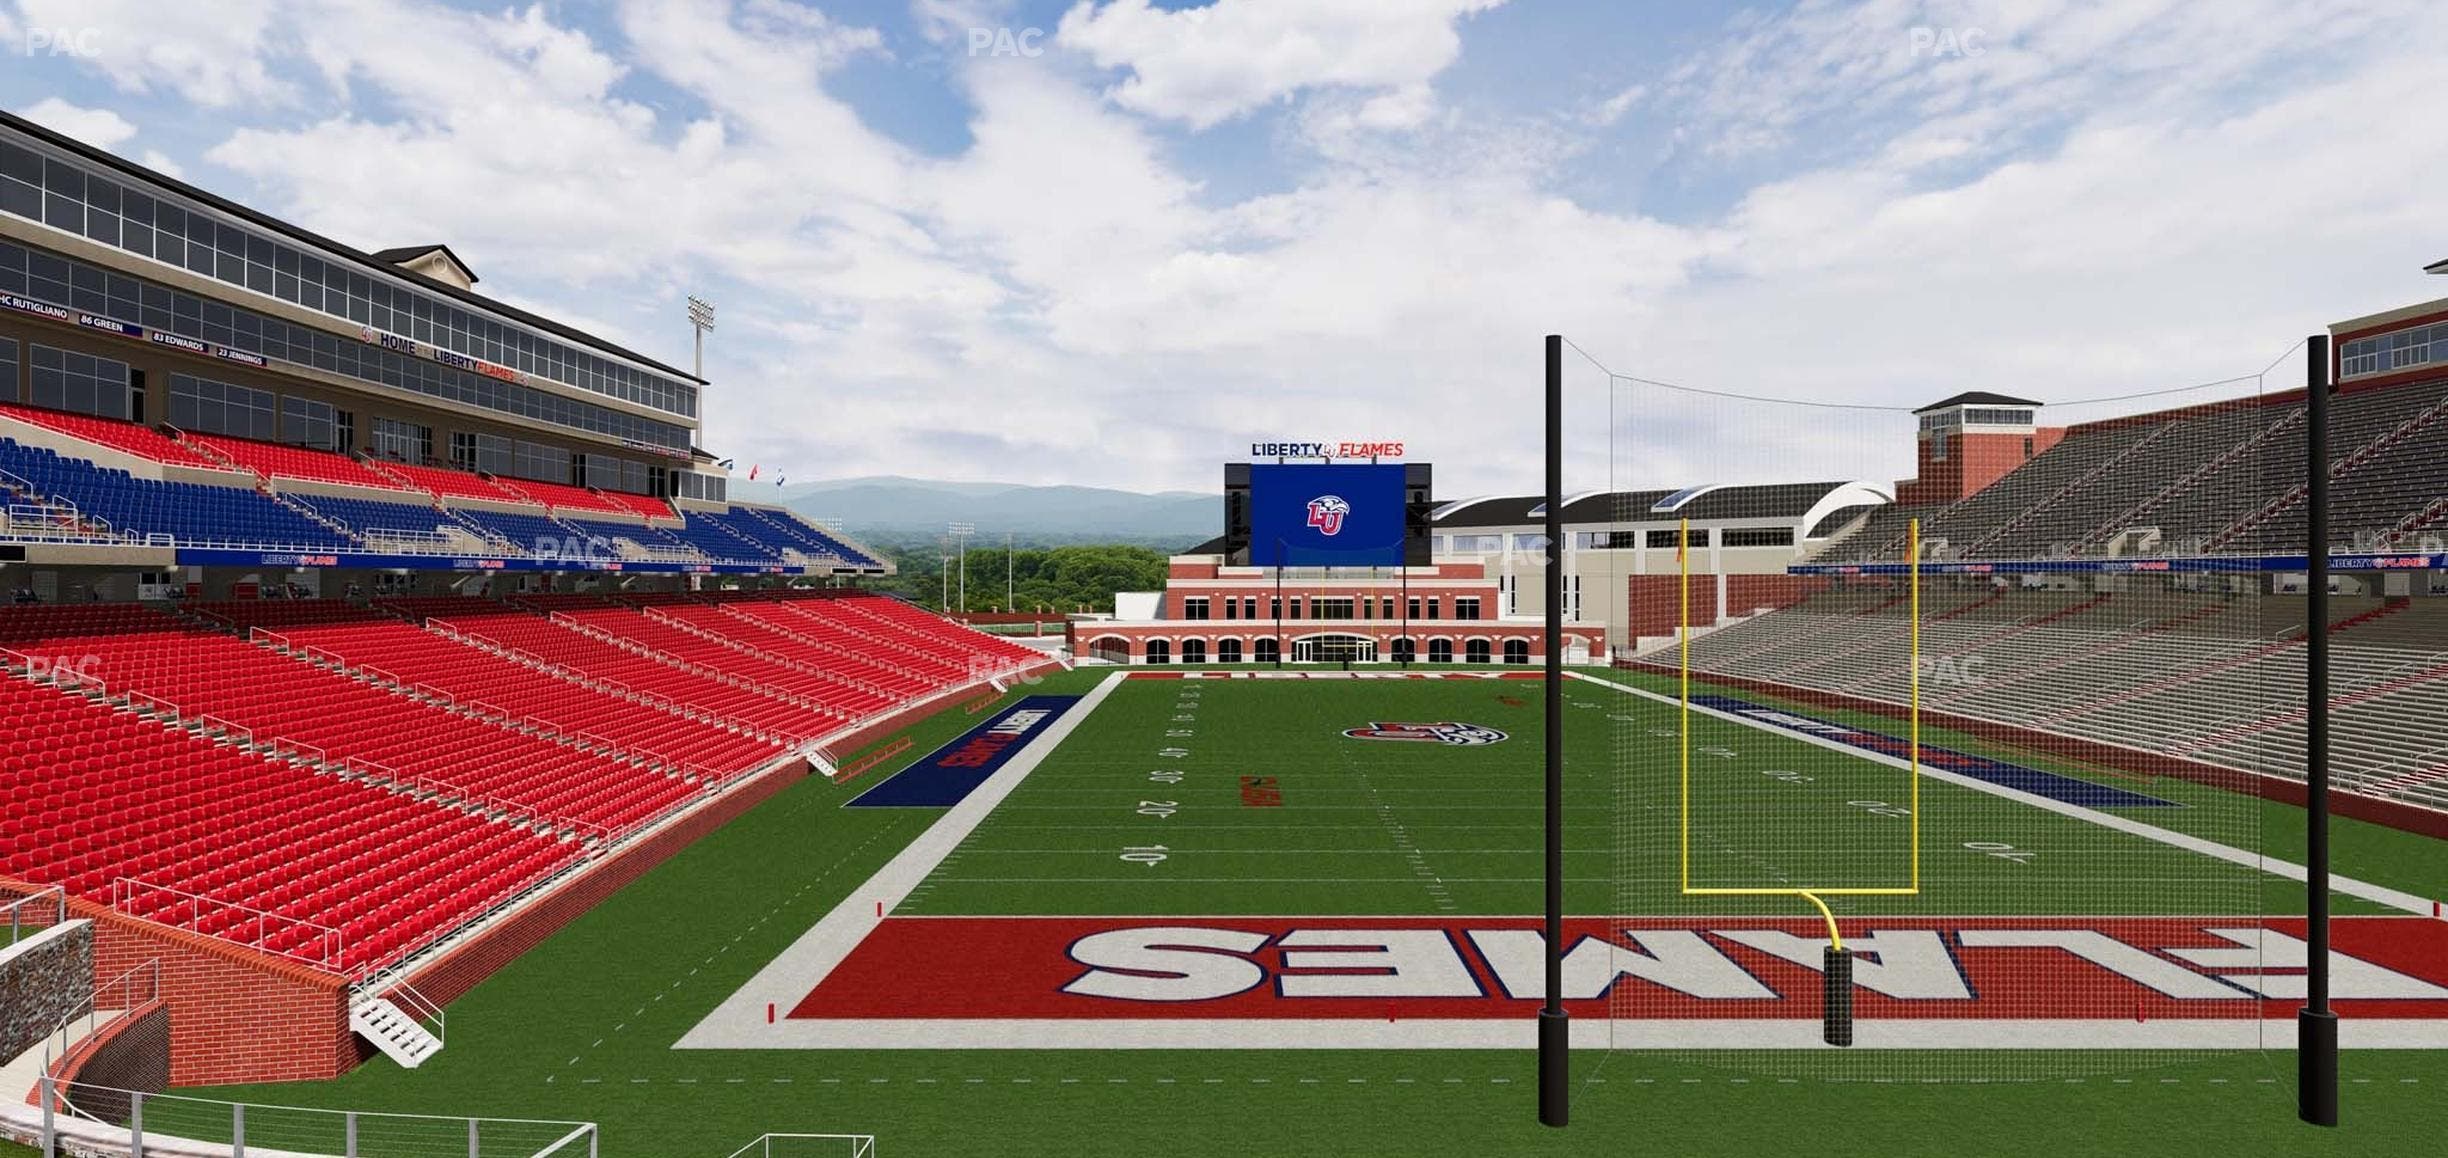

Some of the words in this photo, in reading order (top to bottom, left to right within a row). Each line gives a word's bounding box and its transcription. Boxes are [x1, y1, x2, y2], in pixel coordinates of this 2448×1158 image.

[12, 297, 68, 319] RUTIGLIANO
[80, 314, 93, 325] 86
[93, 317, 124, 332] GREEN
[153, 332, 164, 342] 83
[165, 335, 204, 351] EDWARDS
[380, 332, 416, 355] HOME
[218, 348, 228, 357] 23
[228, 351, 262, 365] JENNINGS
[1252, 443, 1323, 456] LIBERTY
[1339, 443, 1404, 456] FLAMES
[1119, 845, 1169, 862] 10
[1057, 926, 2448, 1002] FLAMES
